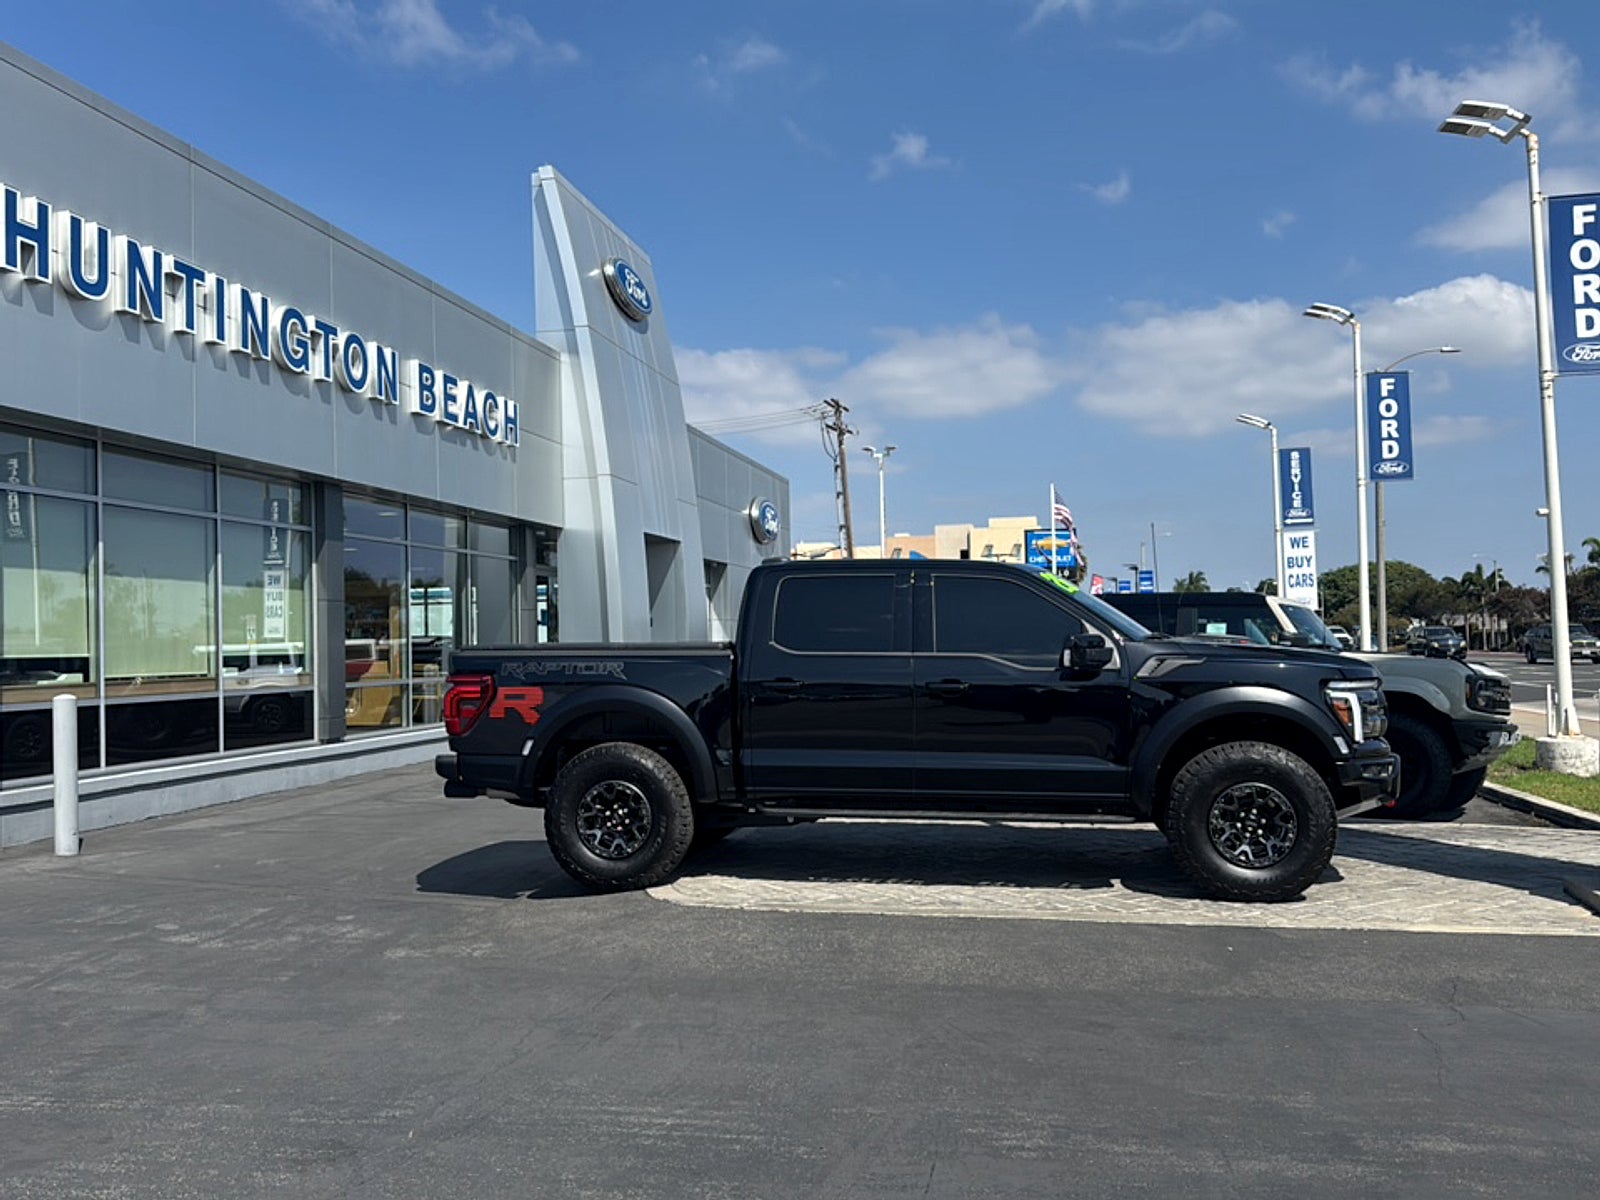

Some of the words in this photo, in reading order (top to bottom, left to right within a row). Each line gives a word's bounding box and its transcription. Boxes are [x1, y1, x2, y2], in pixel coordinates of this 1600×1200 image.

[624, 267, 648, 307] Ford
[1570, 204, 1600, 338] FORD
[1, 185, 400, 405] HUNTINGTON
[411, 360, 519, 447] BEACH
[1379, 378, 1400, 459] FORD
[1290, 451, 1302, 508] SERVICE
[1379, 462, 1404, 474] Ford
[1290, 536, 1309, 549] WE
[1287, 556, 1312, 569] BUY
[1288, 573, 1314, 588] CARS
[501, 661, 627, 680] RAPTOR
[489, 686, 545, 725] R
